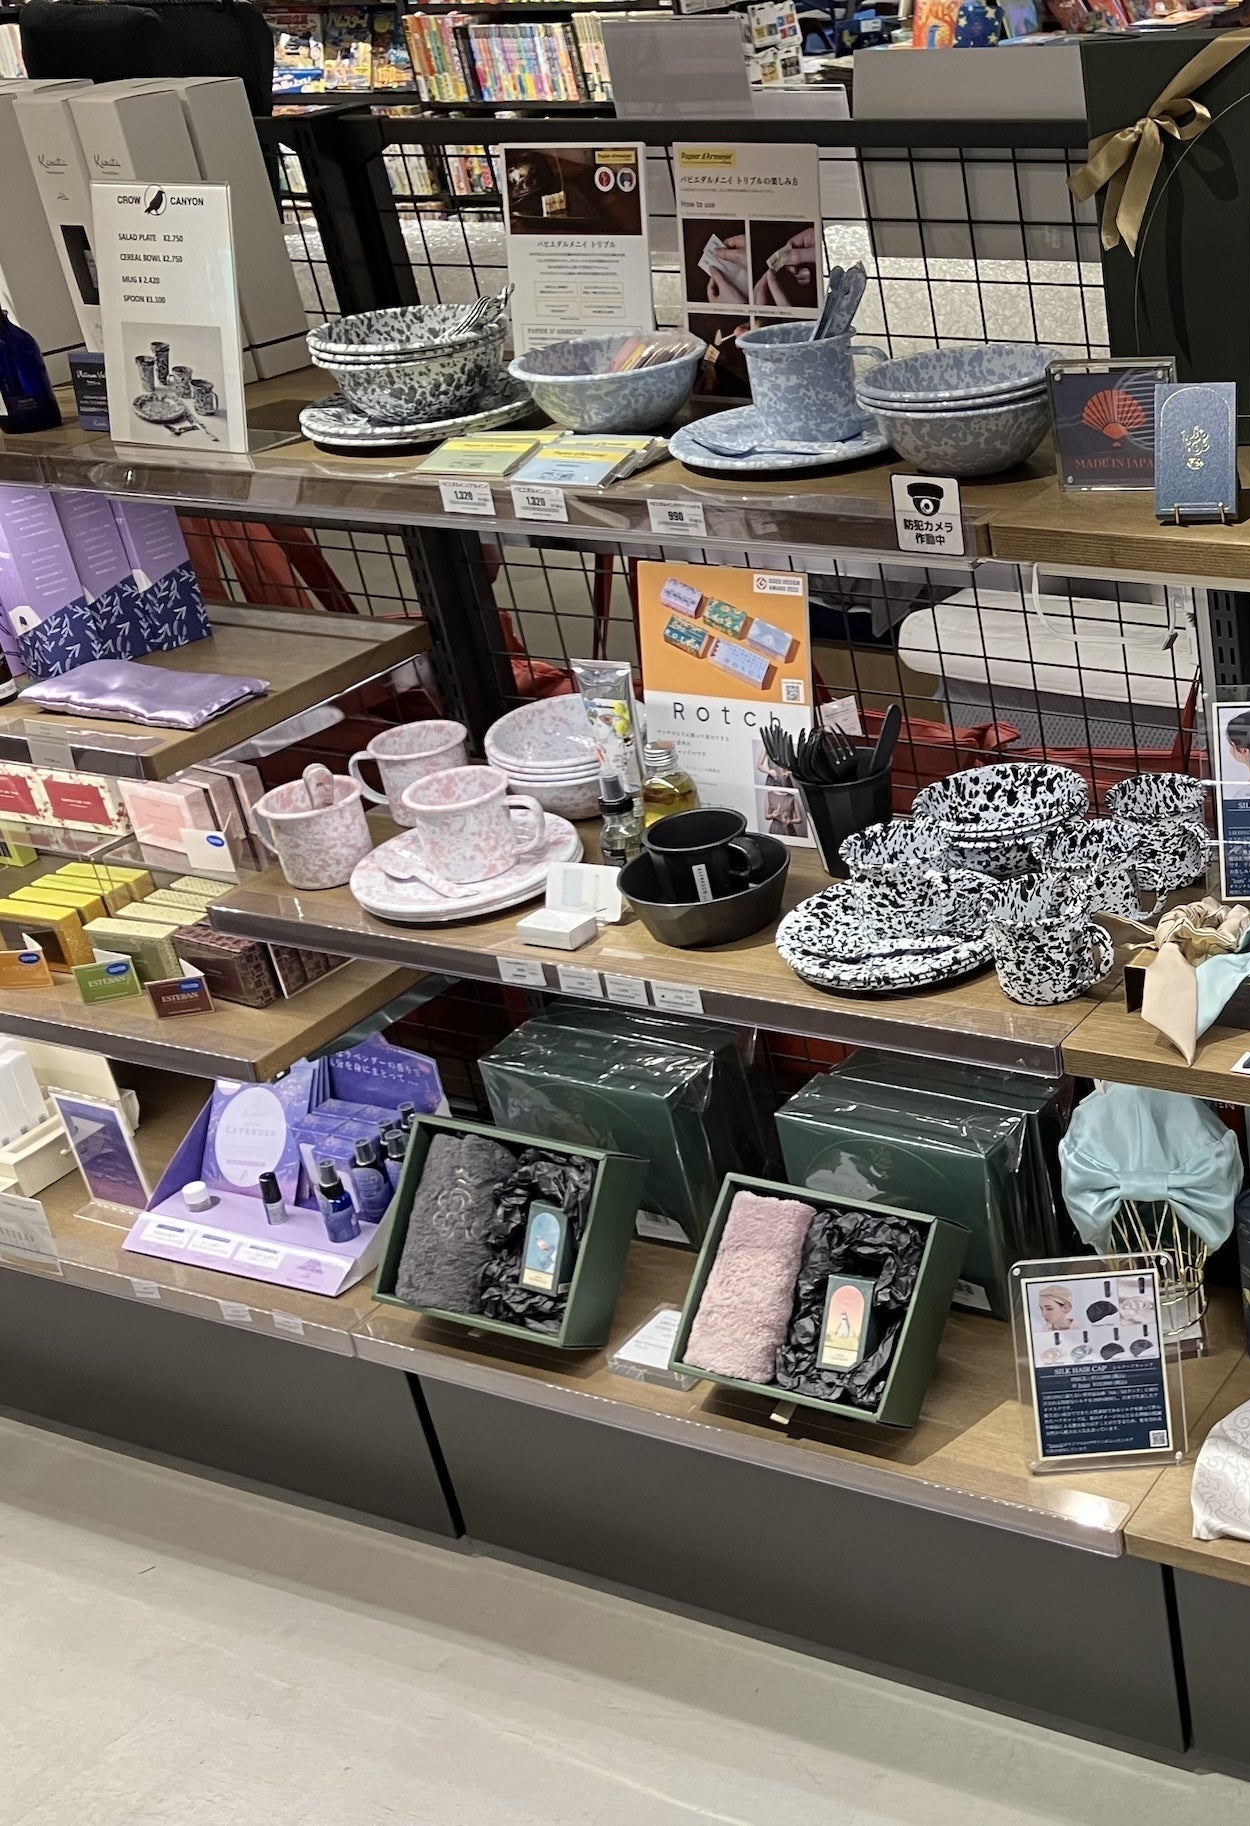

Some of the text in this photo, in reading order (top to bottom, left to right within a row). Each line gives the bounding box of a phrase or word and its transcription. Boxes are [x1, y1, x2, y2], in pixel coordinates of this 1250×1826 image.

[737, 176, 798, 186] トリプルの楽しみ方
[117, 195, 204, 206] CROW CANYON
[118, 233, 138, 241] SALAD
[120, 253, 141, 262] CEREAL
[143, 254, 161, 262] BOWL
[122, 275, 137, 284] MUG
[1074, 459, 1155, 469] MADE IN JAPA
[667, 511, 684, 521] 990
[903, 518, 954, 534] 防犯カメラ
[915, 532, 946, 546] 作動中
[88, 976, 127, 988] ESTEBAN
[161, 992, 199, 1003] ESTEBAN
[1054, 1367, 1071, 1375] SILK
[1072, 1366, 1090, 1374] HAIR
